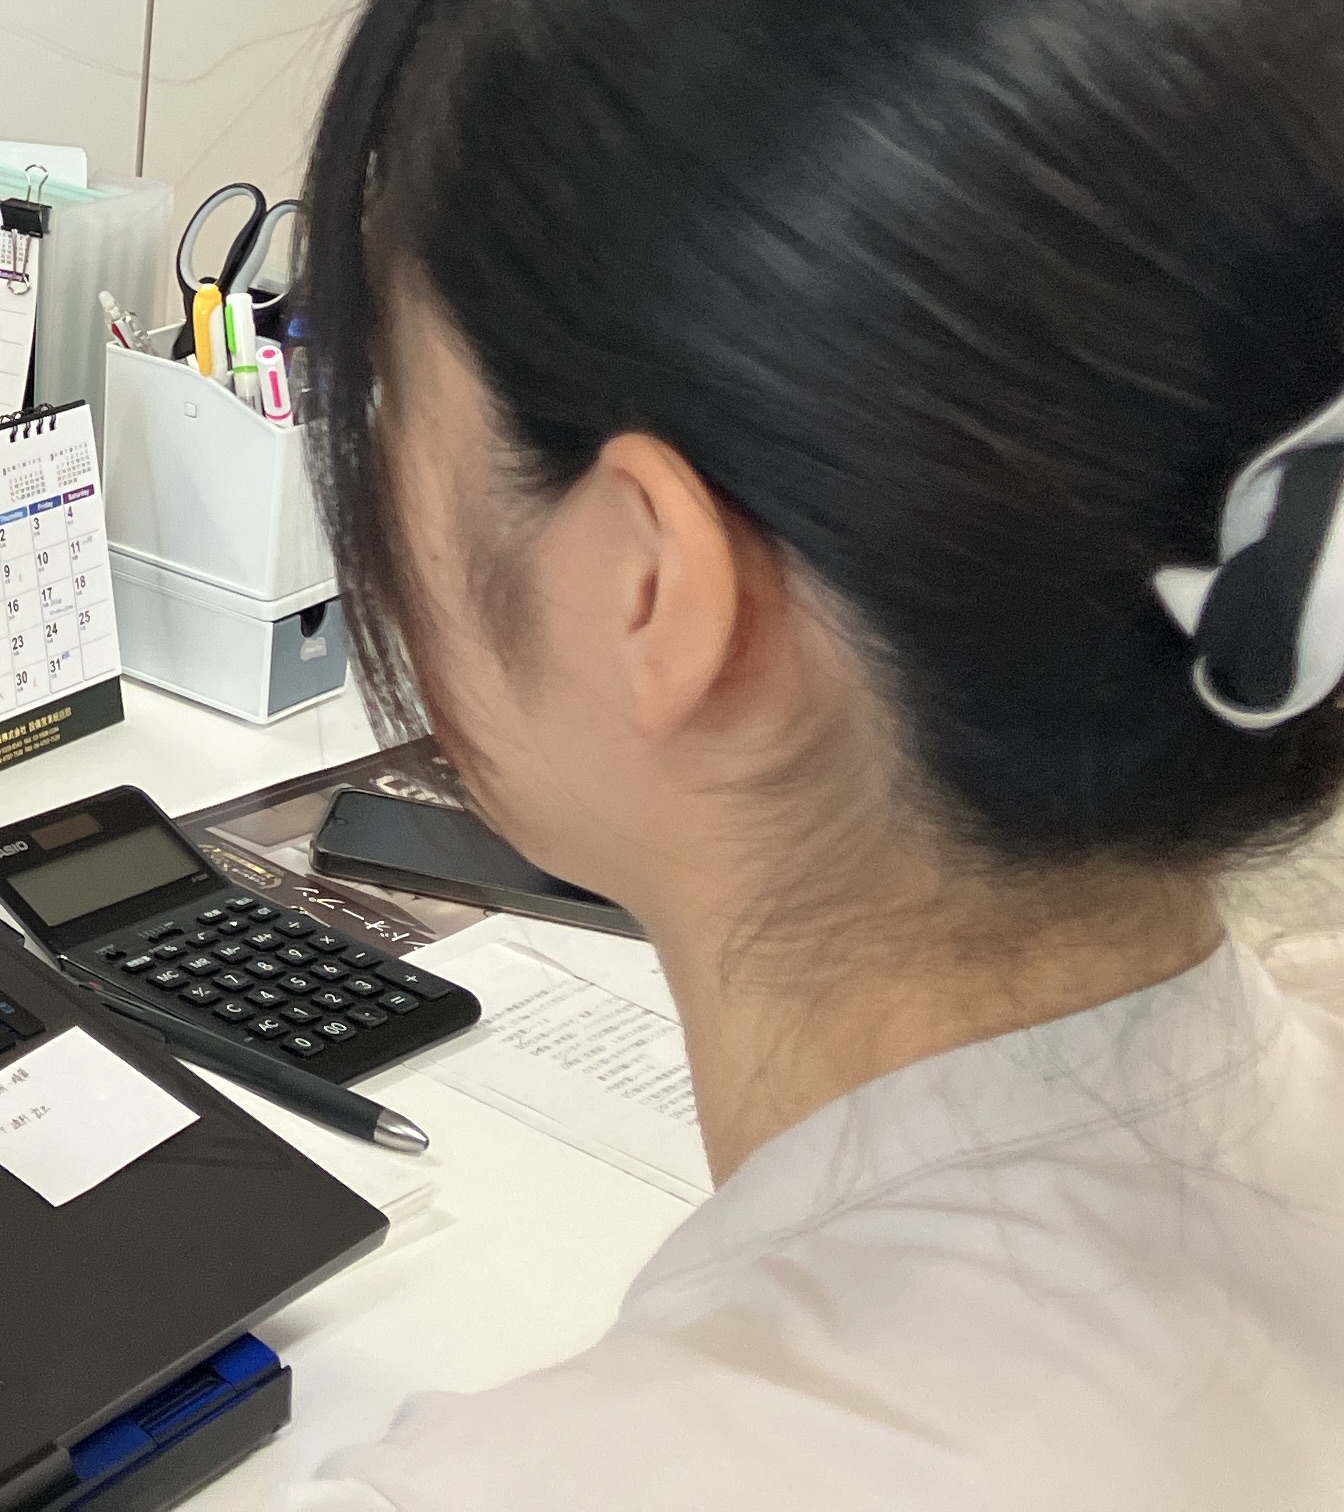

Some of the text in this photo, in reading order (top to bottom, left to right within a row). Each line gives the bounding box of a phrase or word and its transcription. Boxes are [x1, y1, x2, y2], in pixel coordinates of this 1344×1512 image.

[0, 528, 6, 542] 2
[33, 517, 40, 531] 3
[67, 505, 74, 518] 4
[3, 564, 11, 578] 9
[37, 551, 49, 566] 10
[70, 540, 81, 555] 11
[7, 598, 20, 614] 16
[41, 586, 53, 602] 17
[74, 575, 86, 590] 18
[11, 634, 24, 651] 23
[45, 622, 58, 638] 24
[78, 610, 91, 626] 25
[15, 670, 28, 687] 30
[49, 657, 61, 674] 31
[156, 970, 180, 982] MC
[189, 957, 212, 969] MR
[224, 948, 303, 984] 7 8 9
[226, 964, 338, 1013] C 4 5 6
[258, 980, 372, 1032] AC 1 2 3
[294, 1022, 348, 1047] 0 00
